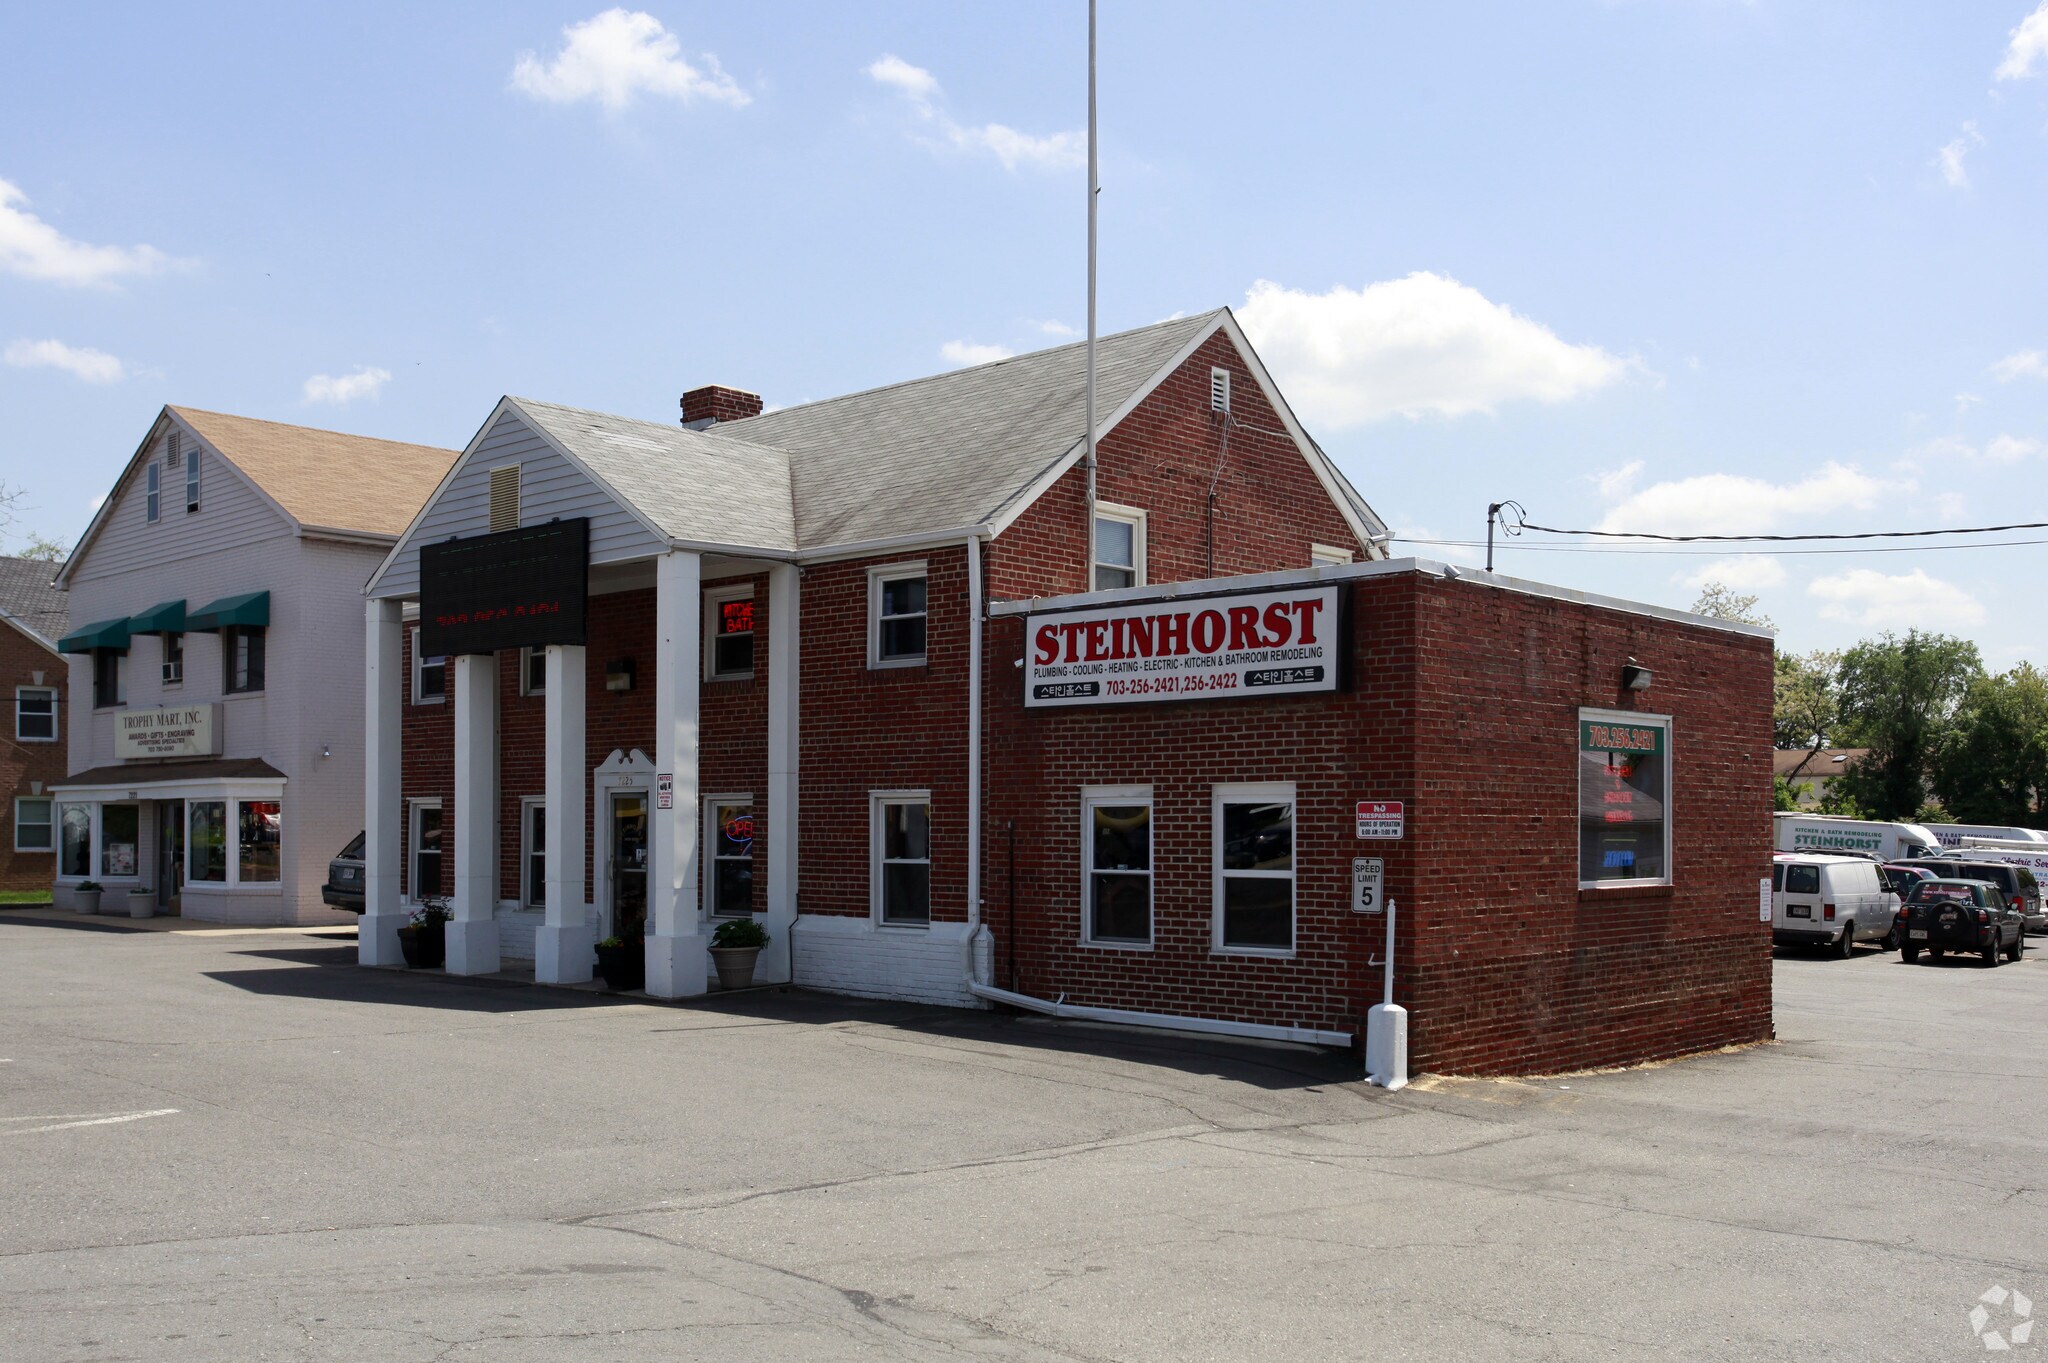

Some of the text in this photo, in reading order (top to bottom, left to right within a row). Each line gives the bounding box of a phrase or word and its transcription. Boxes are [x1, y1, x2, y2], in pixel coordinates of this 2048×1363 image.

[1035, 598, 1323, 666] STEINHORST
[1034, 666, 1068, 678] PLUMBING
[1073, 664, 1103, 676] COOLING
[1108, 661, 1139, 674] HEATING
[1144, 659, 1179, 671] ELECTRIC
[1184, 656, 1218, 669] KITCHEN
[1218, 656, 1224, 667] &
[1225, 650, 1269, 665] BATHROOM
[1271, 647, 1323, 661] REMODELING
[1253, 668, 1315, 685] 스타인홀스트
[1041, 683, 1092, 698] 스타인홀스트
[123, 711, 202, 729] TROPHY MART, INC.
[128, 729, 195, 740] AWARDS GIFTS ENGRAVING
[1589, 725, 1656, 751] 703.256.2421
[1373, 804, 1386, 812] NO
[726, 820, 753, 837] OPE
[1795, 834, 1882, 849] STEINHORST
[1355, 864, 1380, 873] SPEED
[1358, 875, 1377, 883] LIMIT
[1361, 886, 1373, 906] 5
